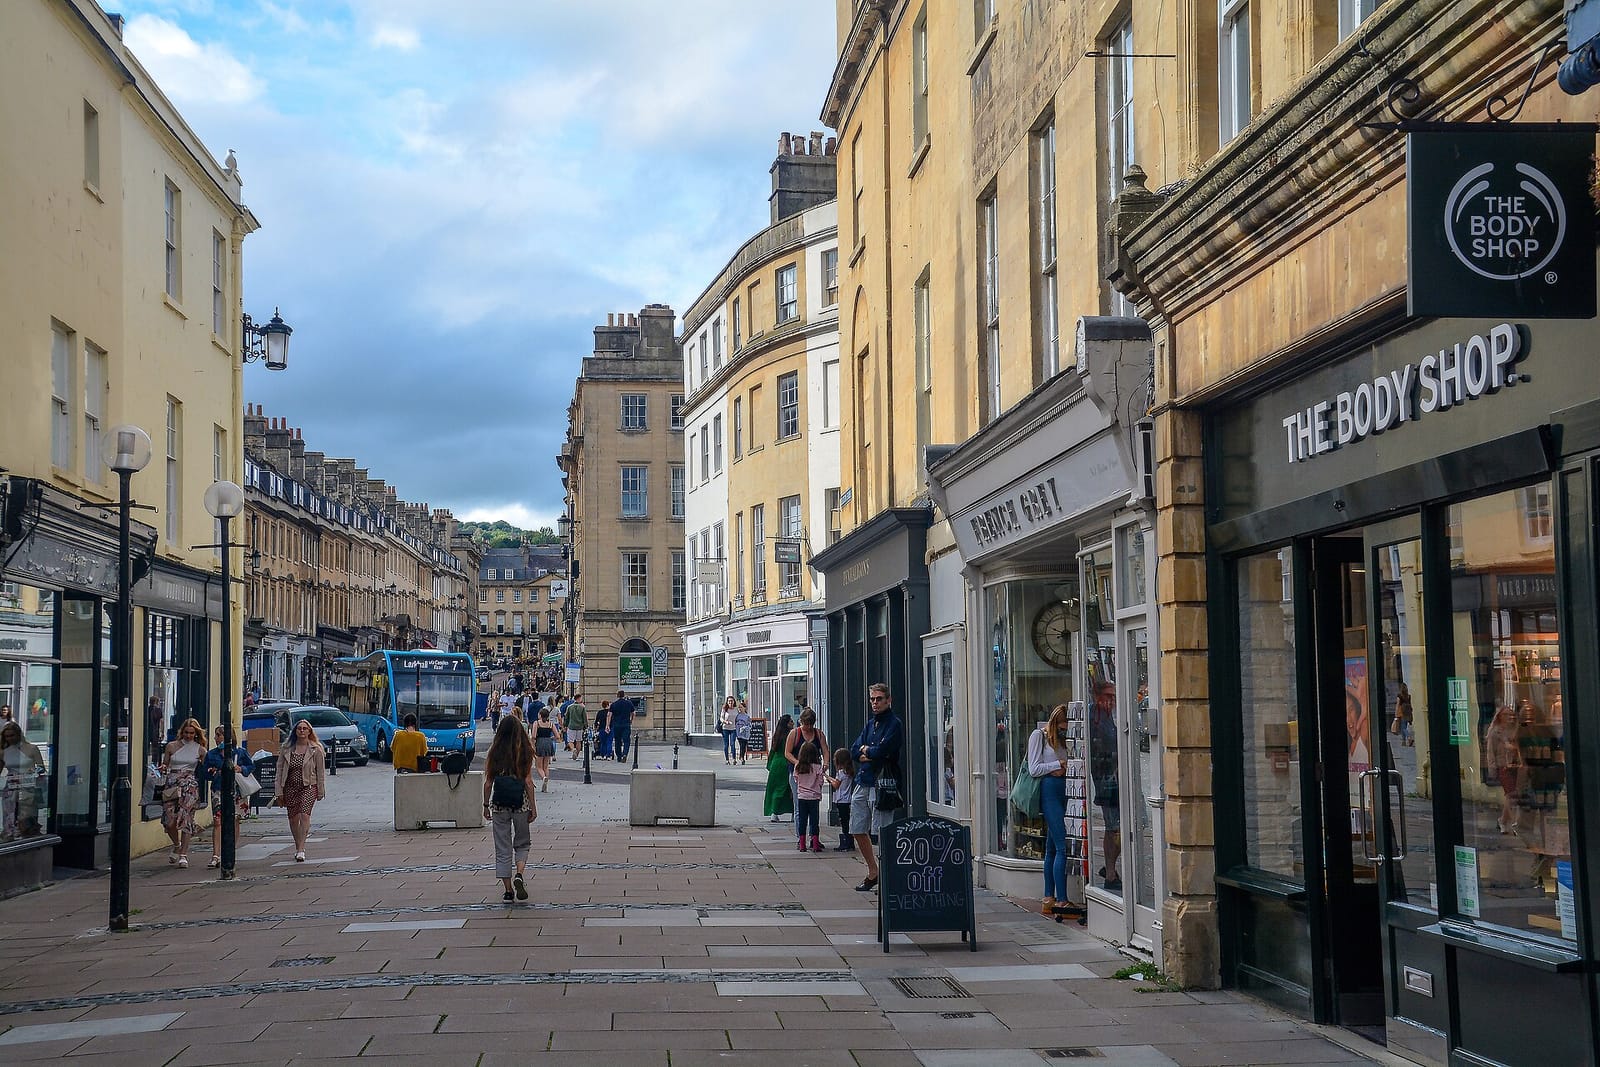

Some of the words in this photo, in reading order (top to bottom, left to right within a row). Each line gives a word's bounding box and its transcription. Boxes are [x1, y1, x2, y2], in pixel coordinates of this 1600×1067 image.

[1484, 196, 1526, 214] THE
[1470, 215, 1541, 236] BODY
[1472, 239, 1540, 258] SHOP
[1282, 400, 1334, 463] THE
[1336, 363, 1414, 445] BODY
[1419, 323, 1521, 413] SHOP
[970, 499, 1021, 546] FRENCH
[452, 660, 459, 671] 7
[896, 834, 964, 865] 20%
[907, 866, 943, 892] off
[888, 893, 964, 911] EVERYTHING
